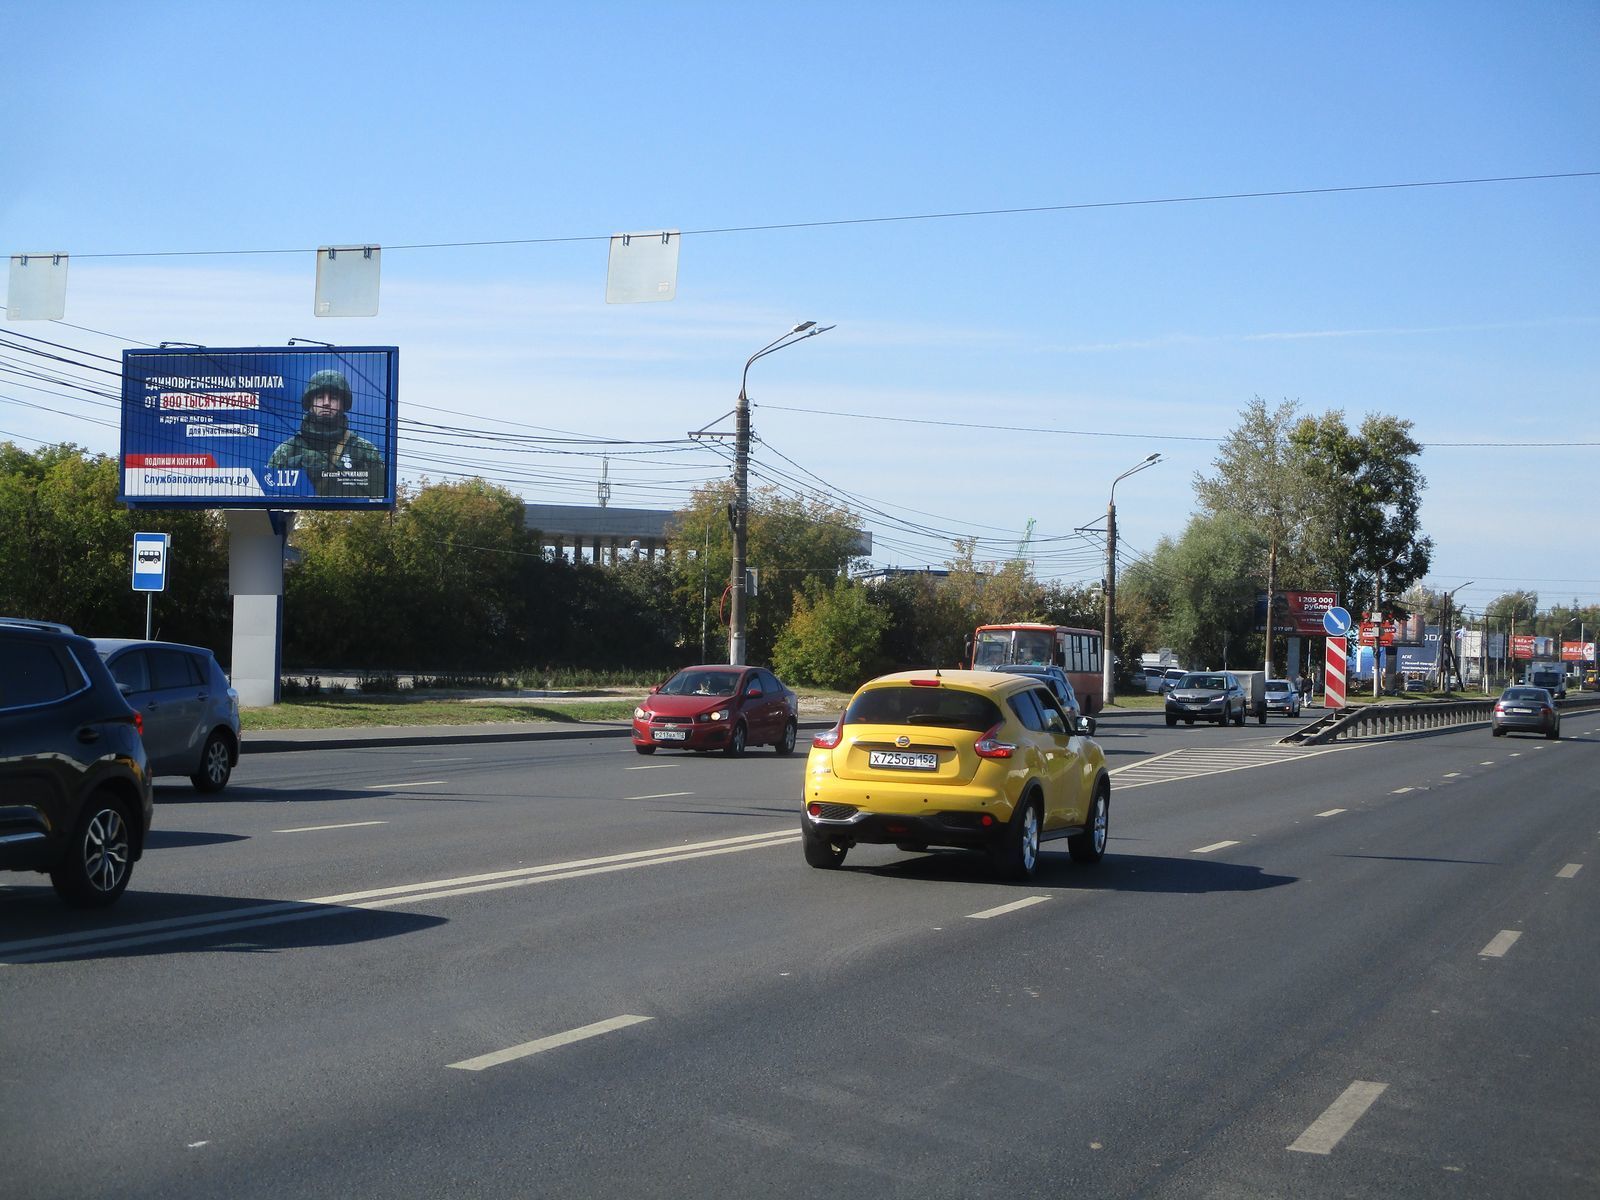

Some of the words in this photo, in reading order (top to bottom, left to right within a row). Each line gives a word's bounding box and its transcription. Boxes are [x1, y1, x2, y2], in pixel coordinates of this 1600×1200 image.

[145, 376, 237, 390] ЕДИНОВРЕМЕННАЯ
[239, 375, 285, 388] ВЫПЛАТА
[144, 396, 157, 408] ОТ
[162, 396, 182, 408] 800
[185, 394, 217, 408] ТЫСЯЧ
[144, 457, 175, 467] ПОДПИШИ
[176, 457, 208, 466] КОНТРАКТ
[144, 474, 250, 486] Службапоконтракту.рф
[277, 470, 300, 487] 117
[873, 752, 915, 766] Х725ОВ
[917, 755, 934, 764] 152
